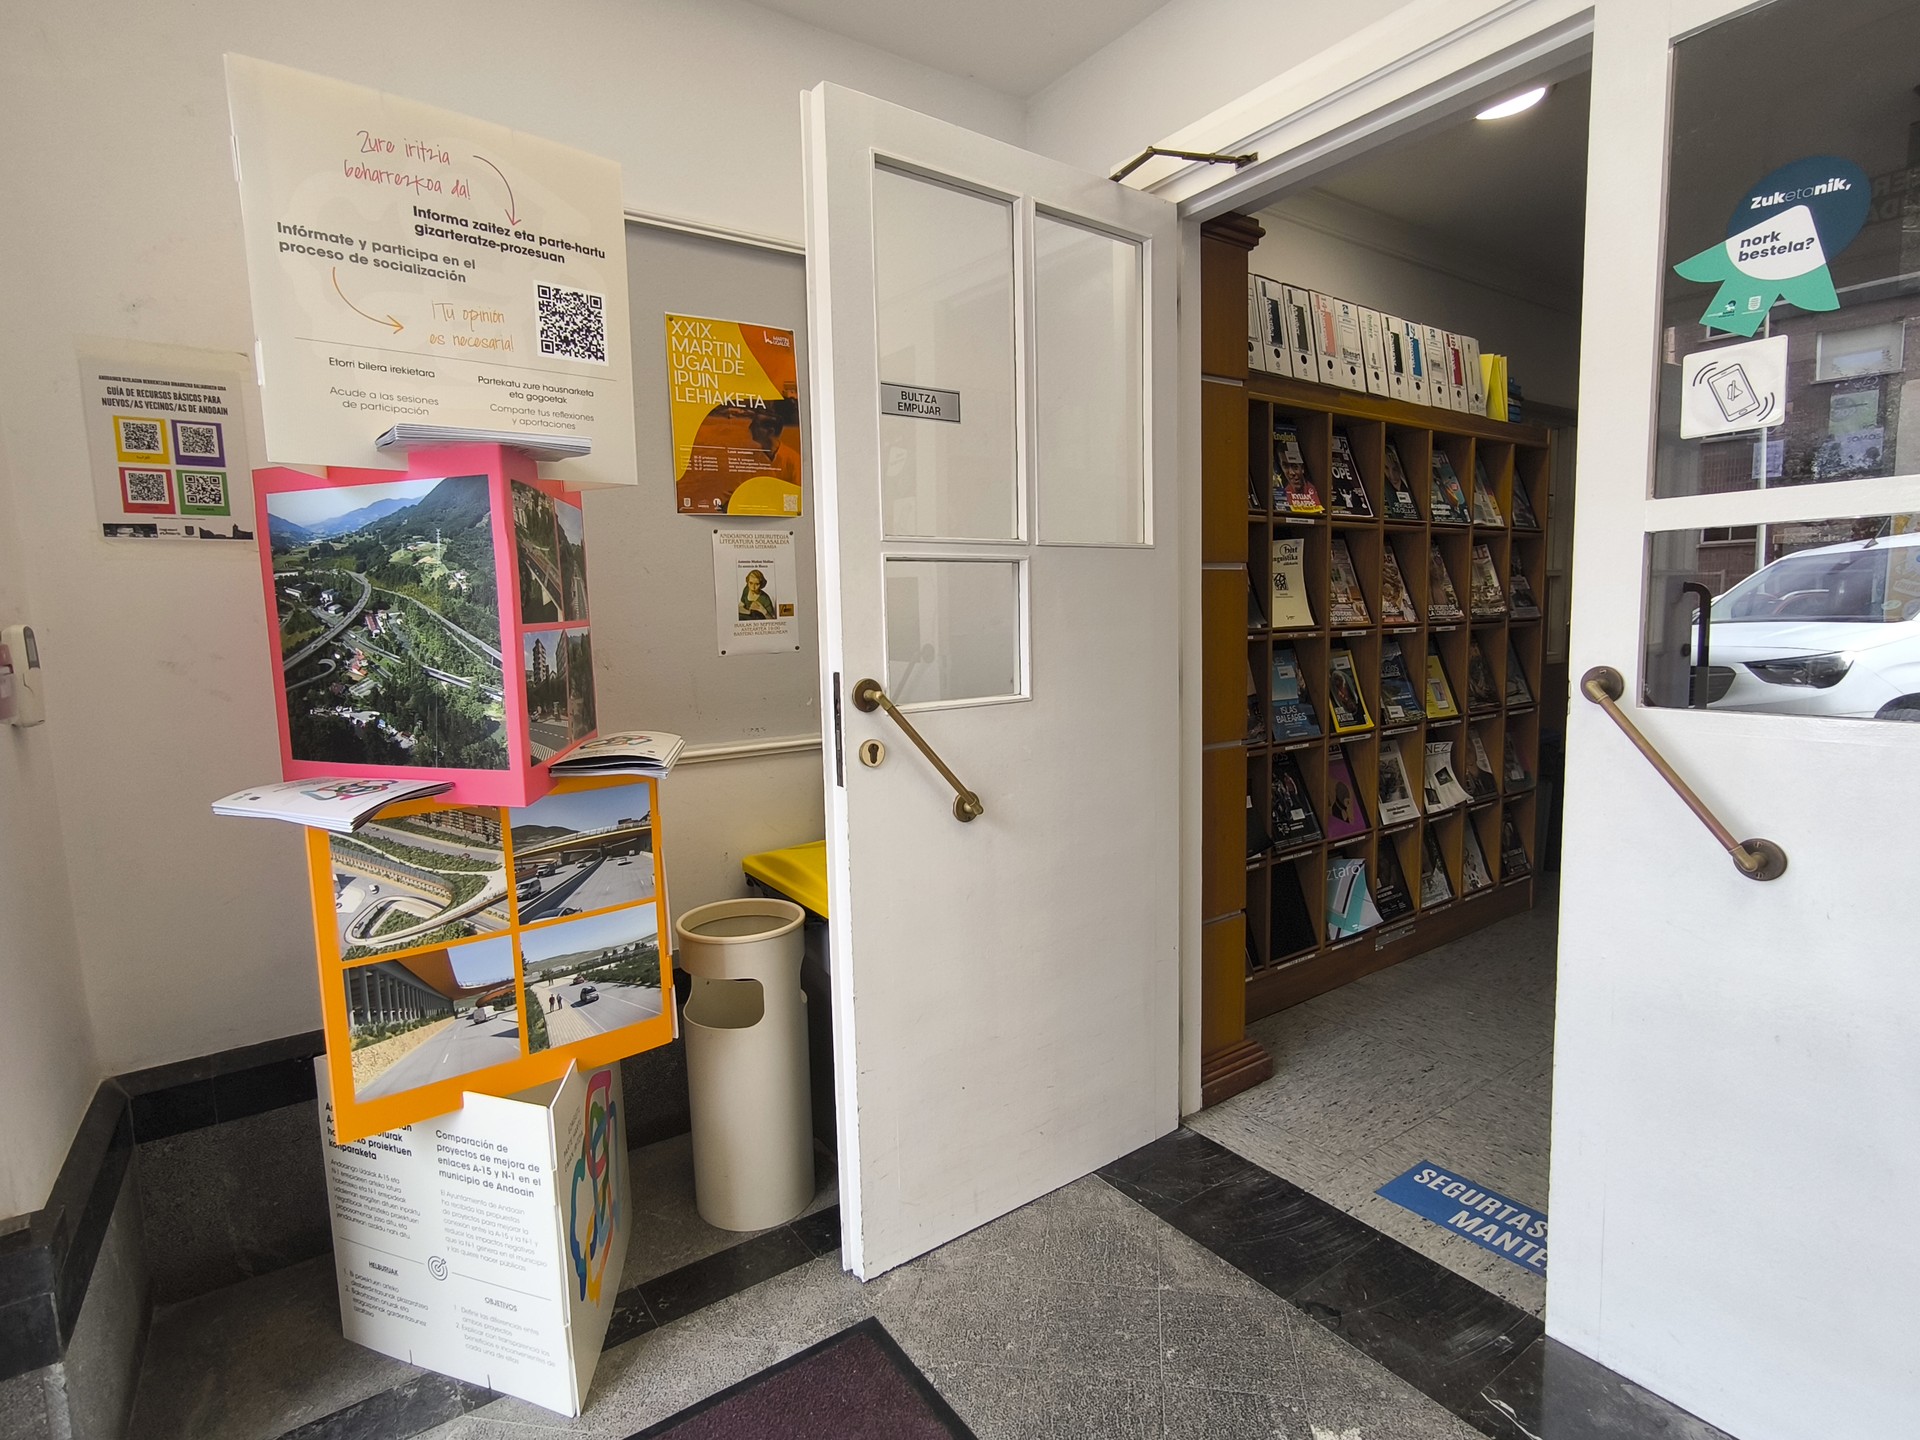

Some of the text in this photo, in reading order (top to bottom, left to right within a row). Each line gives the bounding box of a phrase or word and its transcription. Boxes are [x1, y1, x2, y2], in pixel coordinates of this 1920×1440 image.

[357, 130, 450, 166] Zure iritzia
[344, 159, 471, 200] beharrezkoa da!
[413, 206, 605, 259] Informa zaitez eta parte-hartu
[414, 222, 565, 264] gizarteratze-prozesuan
[1740, 231, 1782, 248] nork
[277, 221, 476, 270] Infórmate y participa en el
[1738, 237, 1815, 262] bestela?
[279, 240, 466, 283] proceso de socialización
[463, 306, 504, 332] opinión
[671, 320, 717, 340] XXIX.
[430, 334, 514, 352] es necesaria!
[672, 336, 741, 359] MARTIN
[328, 356, 435, 379] Etorri bilera irekietara
[673, 352, 745, 376] UGALDE
[478, 375, 594, 398] Partekatu zure hausnarketa
[674, 370, 719, 389] IPUIN
[101, 397, 228, 415] NUEVOS/AS VECINOS/AS DE ANDOAIN
[106, 386, 221, 404] GUÍA DE RECURSOS BÁSICOS PARA
[329, 386, 366, 400] Acude
[379, 391, 394, 402] las
[397, 393, 439, 406] sesiones
[509, 390, 568, 405] eta gogoetak
[675, 386, 767, 410] LEHIAKETA
[901, 390, 937, 404] BULTZA
[342, 398, 430, 416] de participación
[489, 403, 595, 422] Comparte tus reflexiones
[897, 401, 941, 416] EMPUJAR
[519, 417, 576, 431] aportaciones
[1276, 712, 1307, 724] BALEARES
[1280, 705, 1298, 714] ISLAS
[369, 1139, 412, 1157] proiektuen
[436, 1129, 508, 1153] Comparación de
[437, 1144, 540, 1173] proyectos de mejora de
[438, 1157, 471, 1171] enlaces
[473, 1164, 492, 1175] A-15
[502, 1171, 515, 1180] N-1
[518, 1175, 530, 1184] en
[533, 1178, 541, 1186] el
[439, 1169, 535, 1198] municipio de Andoain
[1413, 1168, 1548, 1243] SEGURTAS
[1447, 1209, 1548, 1271] MANTE
